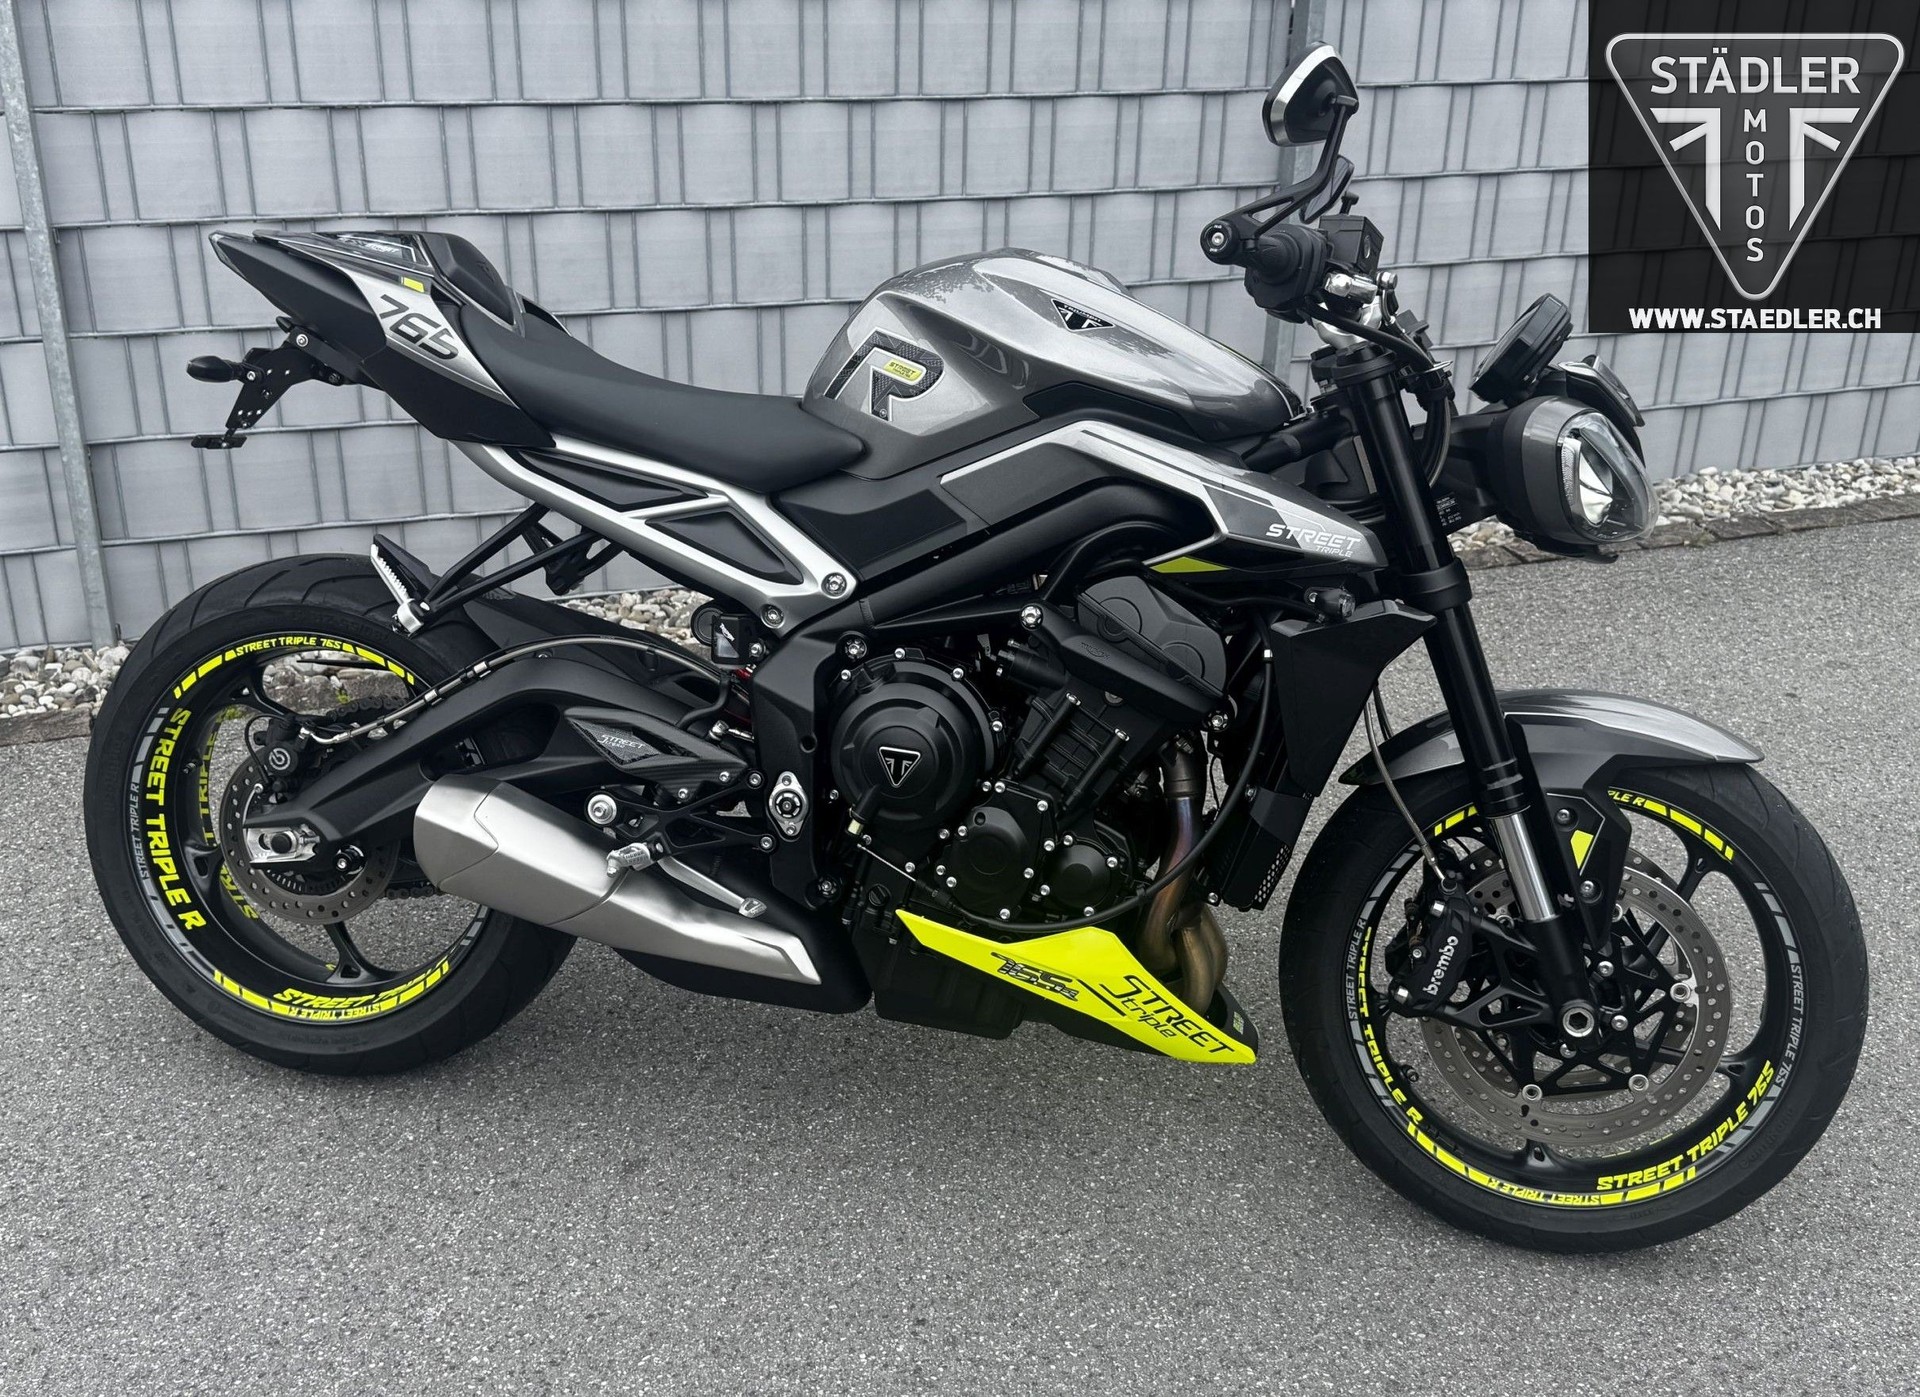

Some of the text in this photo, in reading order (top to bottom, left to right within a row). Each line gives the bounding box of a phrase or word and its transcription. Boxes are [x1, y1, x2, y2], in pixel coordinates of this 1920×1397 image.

[379, 294, 459, 360] 765
[1265, 523, 1361, 550] STREET
[1315, 545, 1353, 558] TRIPLE
[235, 636, 342, 657] STREET TRIPLE 765
[146, 707, 207, 931] STREET TRIPLE R
[1632, 796, 1646, 807] R
[129, 782, 150, 878] STREET TRIPLE R
[1345, 918, 1367, 1022] STREET TRIPLE R
[1422, 935, 1459, 996] brembo
[273, 987, 376, 1009] STREET
[1790, 964, 1804, 1014] STREET
[289, 1004, 381, 1021] STREET TRIPLE R
[1099, 974, 1235, 1054] STREET
[1120, 998, 1178, 1039] triple
[1784, 1017, 1803, 1061] TRIPLE
[1596, 1151, 1685, 1190] STREET
[1686, 1101, 1750, 1166] TRIPLE
[1747, 1060, 1775, 1106] 765
[1487, 1177, 1601, 1206] STREET TRIPLE R
